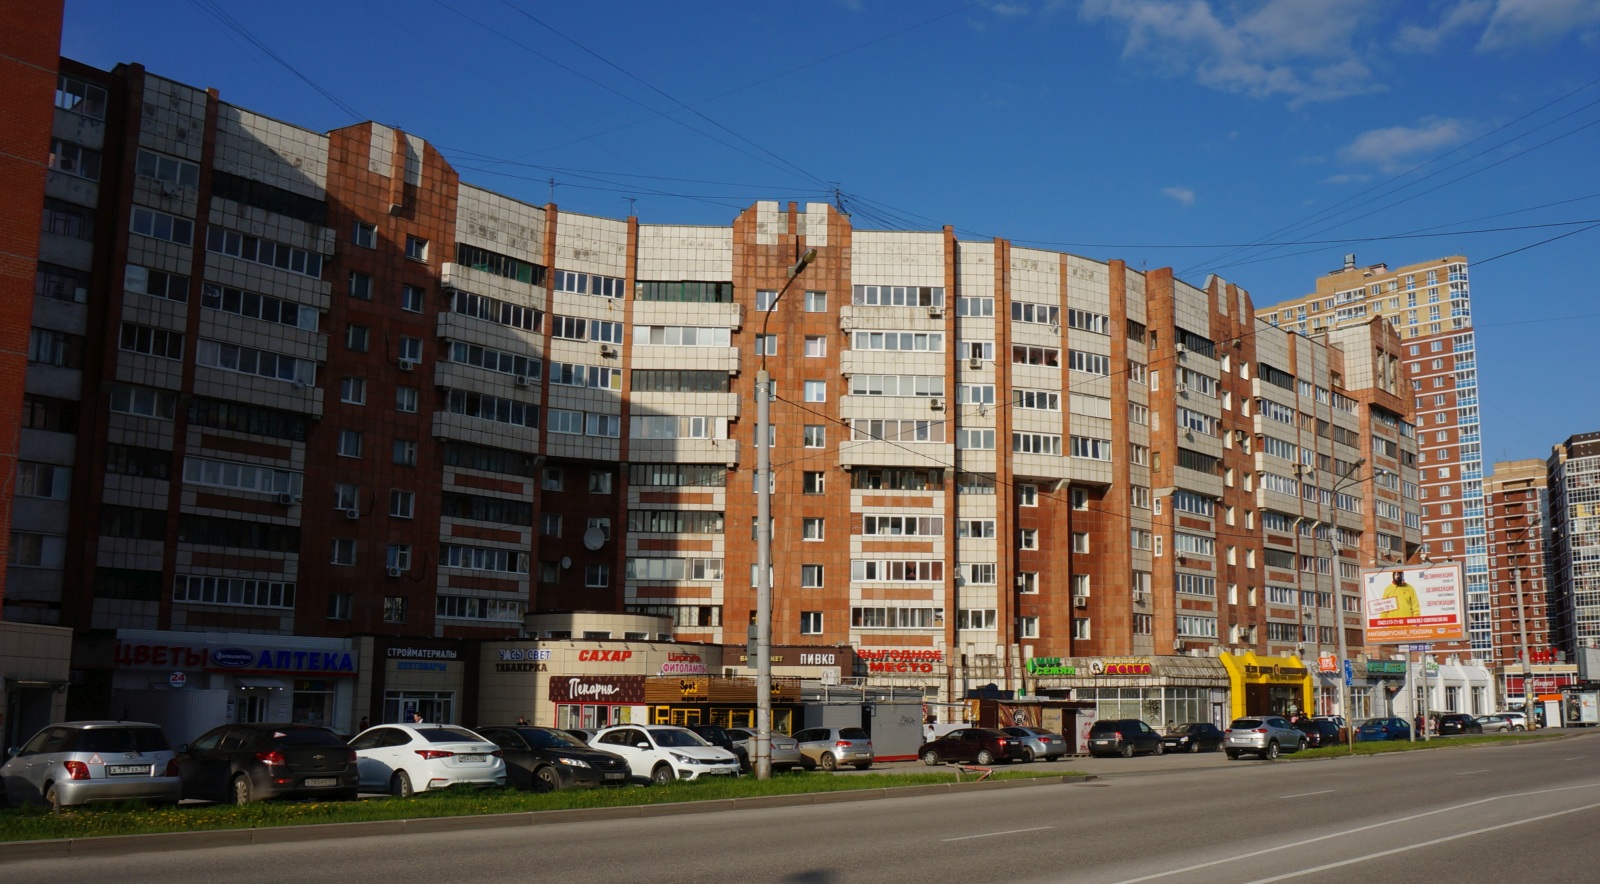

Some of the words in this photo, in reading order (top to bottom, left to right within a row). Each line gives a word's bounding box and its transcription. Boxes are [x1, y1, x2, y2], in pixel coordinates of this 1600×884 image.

[114, 643, 208, 667] ЦВЕТЫ
[387, 647, 457, 658] СТРОЙМАТЕРИАЛЫ
[527, 650, 551, 660] СВЕТ
[578, 650, 632, 662] САХАР
[857, 649, 943, 661] ВЫГОДНОЕ
[257, 650, 353, 671] АПТЕКА
[800, 653, 835, 665] ПИВКО
[496, 663, 548, 672] ТАБАКЕРКА
[870, 662, 933, 673] МЕСТО
[1036, 667, 1075, 676] СЕМЯН
[569, 678, 620, 699] Пекарня
[680, 680, 696, 692] Spot
